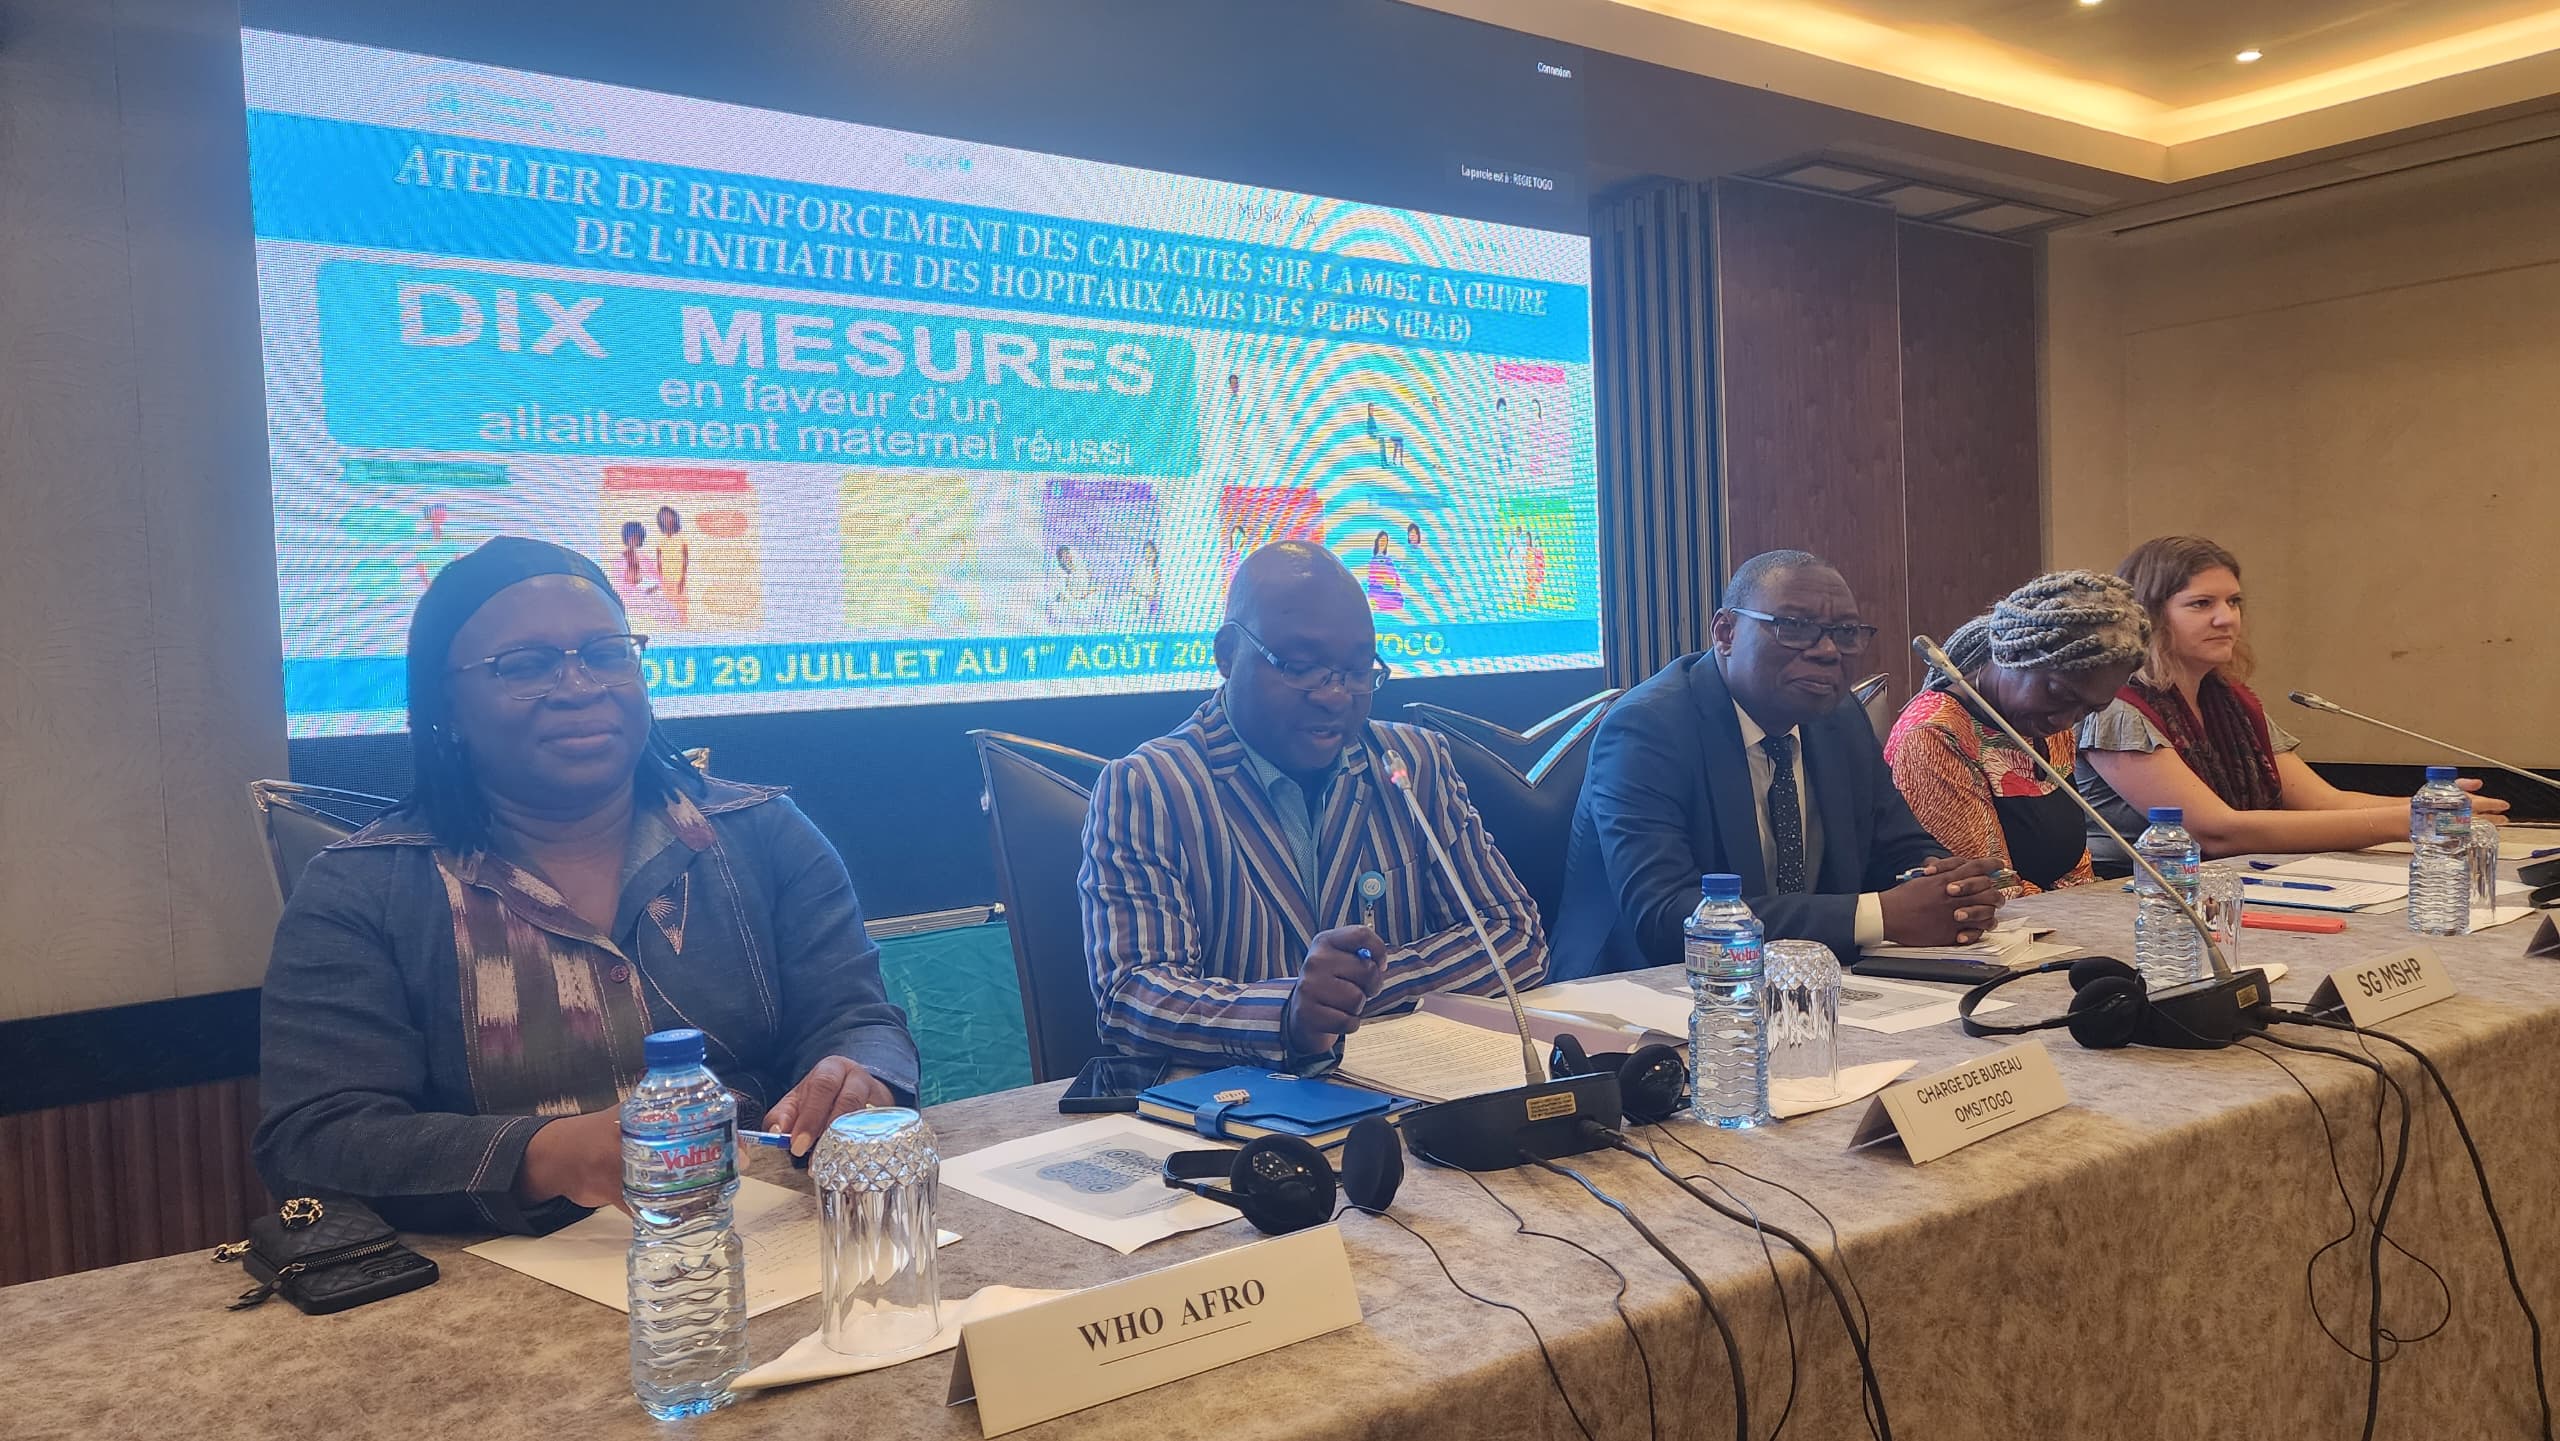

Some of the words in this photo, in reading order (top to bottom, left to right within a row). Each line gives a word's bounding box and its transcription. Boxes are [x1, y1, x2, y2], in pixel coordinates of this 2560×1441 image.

[1533, 177, 1553, 191] TOGO
[394, 144, 600, 206] ATELIER
[617, 171, 674, 214] DE
[687, 182, 1007, 252] RENFORCEMENT
[1017, 223, 1078, 262] DES
[1087, 234, 1252, 283] CAPACITES
[1259, 257, 1312, 292] SUR
[1319, 263, 1353, 295] LA
[1360, 268, 1421, 302] MISE
[1427, 277, 1459, 306] EN
[574, 216, 636, 259] DE
[648, 225, 901, 286] L'INITIATIVE
[913, 255, 980, 293] DES
[991, 264, 1163, 313] HOPITAUX
[1173, 285, 1246, 320] AMIS
[1253, 292, 1303, 326] DES
[398, 281, 610, 359] DIX
[680, 304, 1153, 397] MESURES
[658, 377, 724, 409] en
[743, 375, 895, 420] faveur
[910, 387, 1002, 424] d'un
[479, 403, 782, 452] allaitement
[800, 423, 999, 461] maternel
[1012, 429, 1132, 466] réussi
[641, 656, 696, 688] DU
[711, 655, 761, 686] 29
[776, 649, 943, 683] JUILLET
[956, 647, 1008, 675] AU
[1066, 635, 1158, 670] AOÛT
[1172, 639, 1215, 667] 20
[2357, 971, 2383, 997] SG
[2378, 958, 2422, 990] MSHP
[1917, 1076, 1965, 1104] CHARGE
[1963, 1070, 1980, 1088] DE
[1979, 1056, 2022, 1082] BUREAU
[1955, 1090, 2013, 1122] OMS/TOGO
[660, 1143, 722, 1171] Voltic
[1077, 1306, 1164, 1352] WHO
[1180, 1279, 1266, 1327] AFRO
